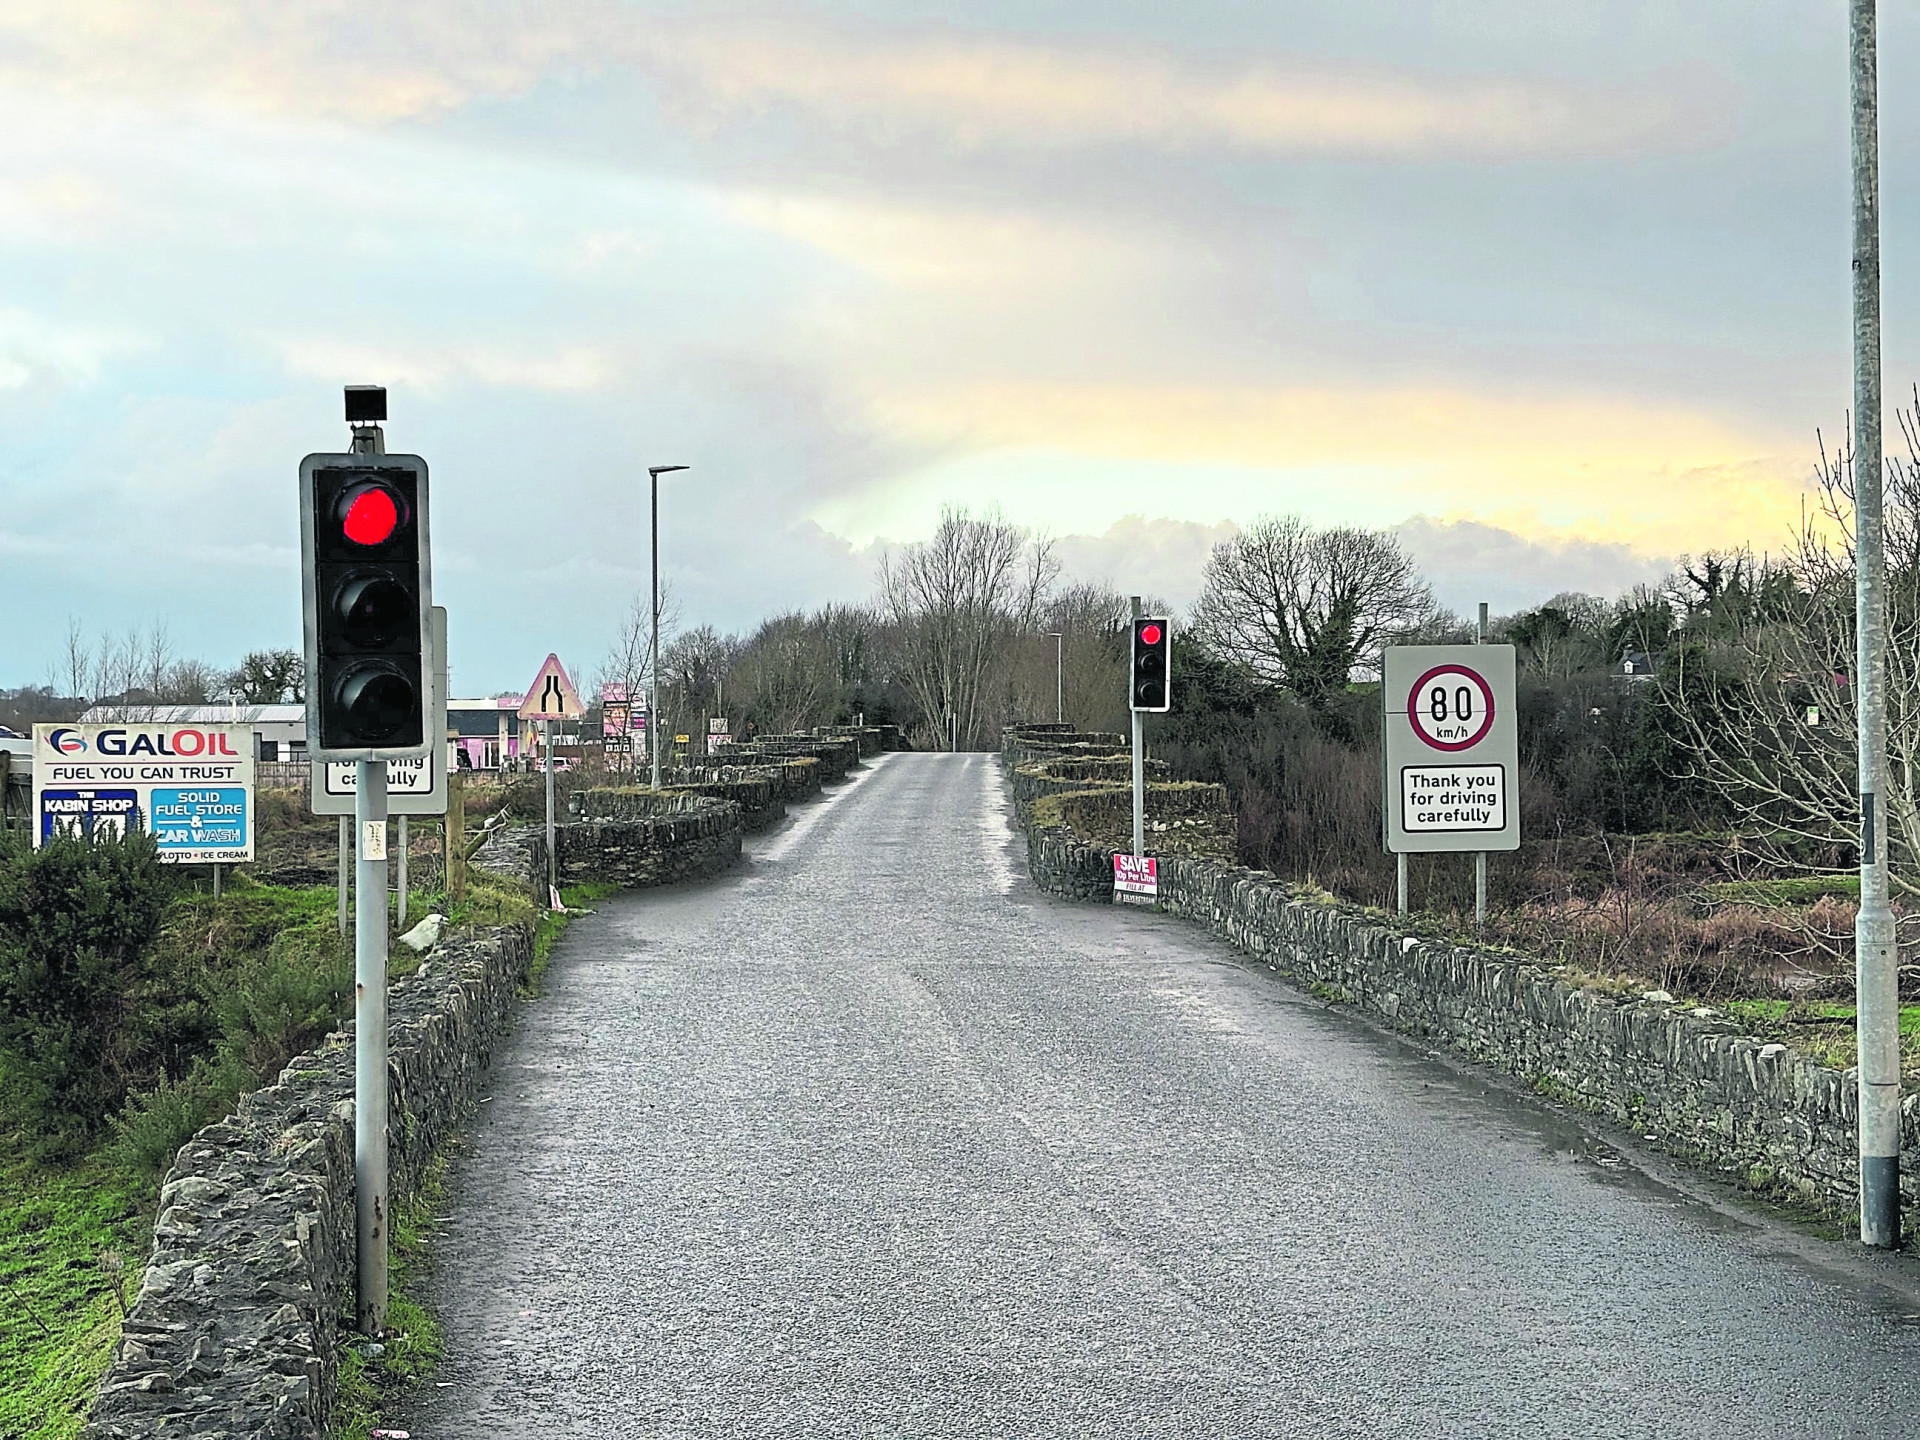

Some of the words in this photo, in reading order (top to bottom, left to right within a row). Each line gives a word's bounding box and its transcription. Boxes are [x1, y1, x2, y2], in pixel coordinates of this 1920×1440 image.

[1431, 686, 1472, 722] 80
[1437, 725, 1468, 739] km/h
[53, 768, 95, 779] FUEL
[100, 767, 134, 779] YOU
[140, 767, 173, 779] CAN
[179, 767, 235, 779] TRUST
[341, 771, 418, 787] caully
[1410, 773, 1461, 788] Thank
[1466, 776, 1495, 789] you
[178, 792, 220, 803] SOLID
[1410, 792, 1434, 805] for
[1440, 791, 1497, 806] driving
[44, 799, 89, 812] KABIN
[91, 799, 134, 812] SHOP
[156, 805, 191, 815] FUEL
[195, 804, 242, 815] STORE
[190, 815, 203, 828] &
[1417, 808, 1491, 824] carefully
[190, 828, 241, 842] WASH
[200, 851, 215, 859] ICE
[217, 851, 248, 859] CREAM
[1120, 856, 1149, 873] SAVE
[1128, 872, 1139, 881] Per
